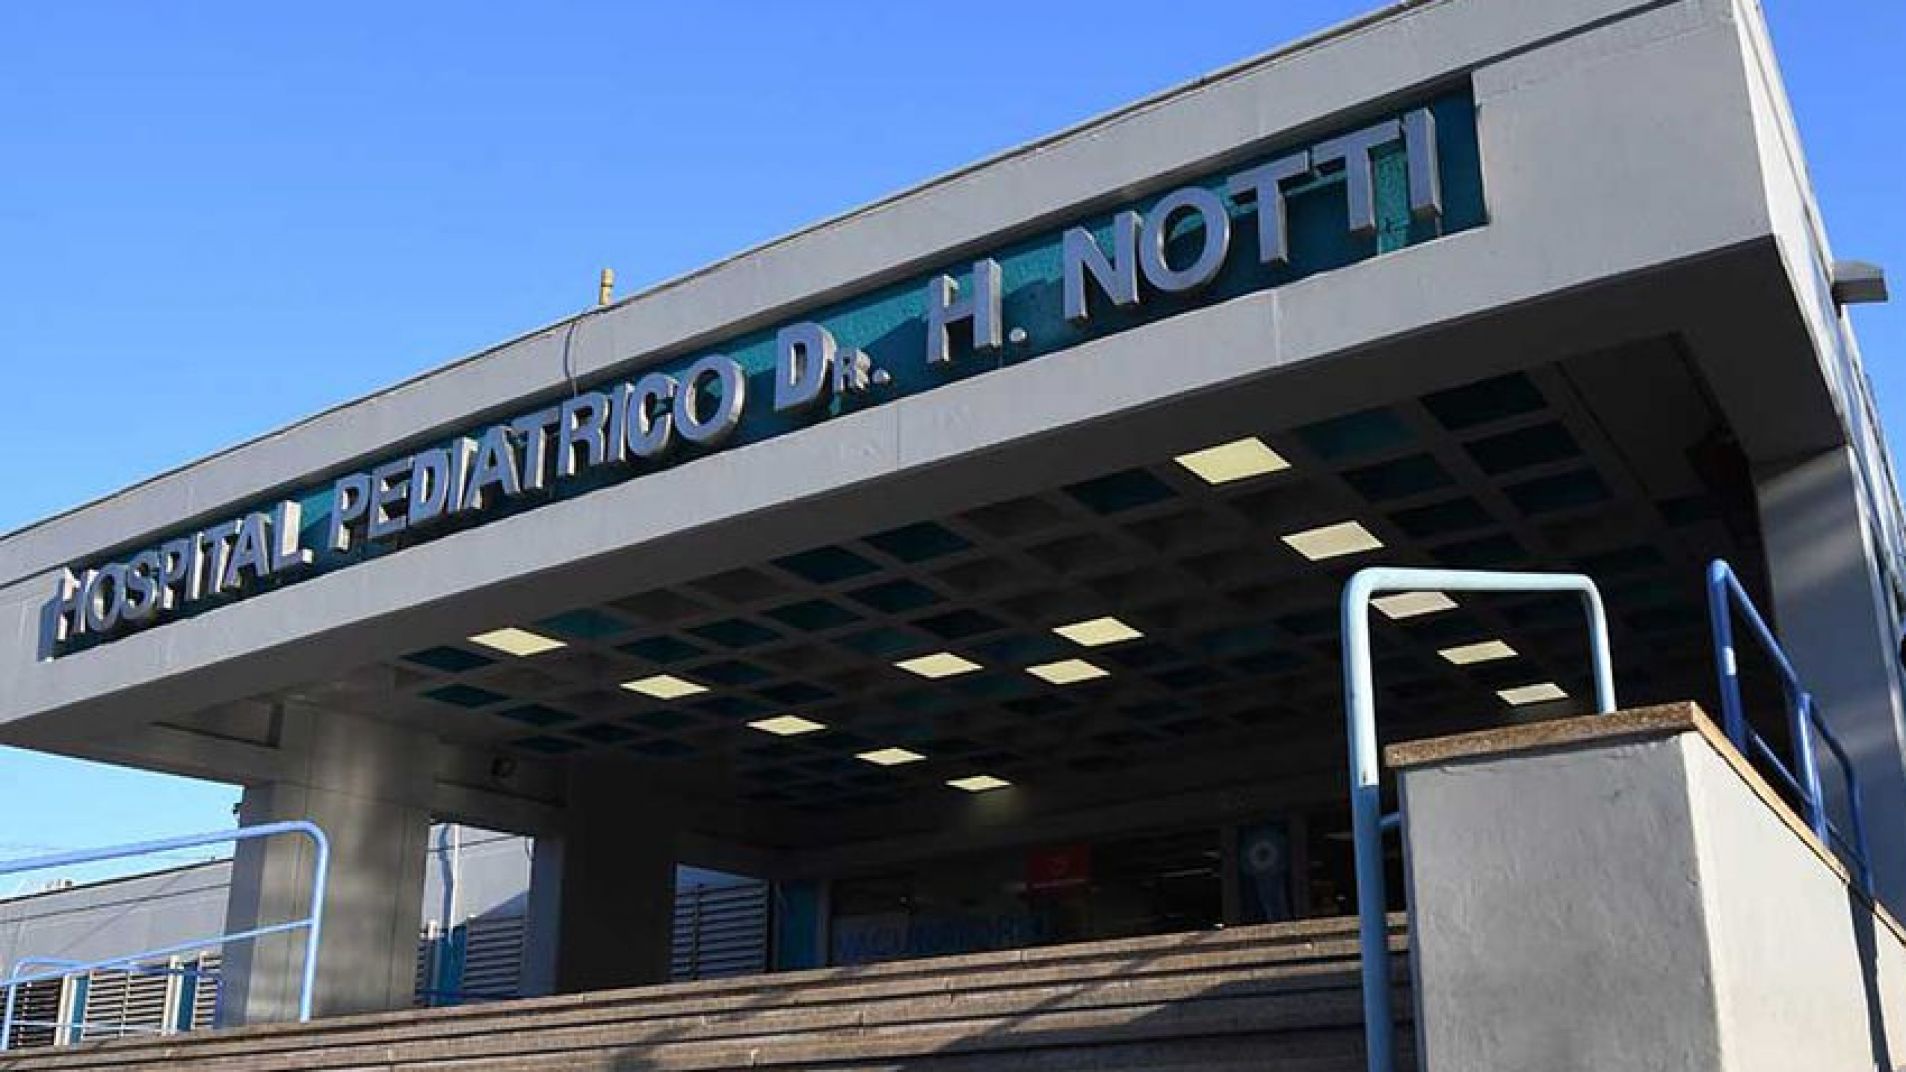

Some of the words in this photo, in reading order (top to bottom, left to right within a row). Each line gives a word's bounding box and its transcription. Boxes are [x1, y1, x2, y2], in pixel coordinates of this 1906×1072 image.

[53, 499, 313, 642] HOSPITAL
[329, 354, 746, 549] PEDIATRICO
[927, 258, 1028, 362] H.
[1063, 107, 1442, 319] NOTTI
